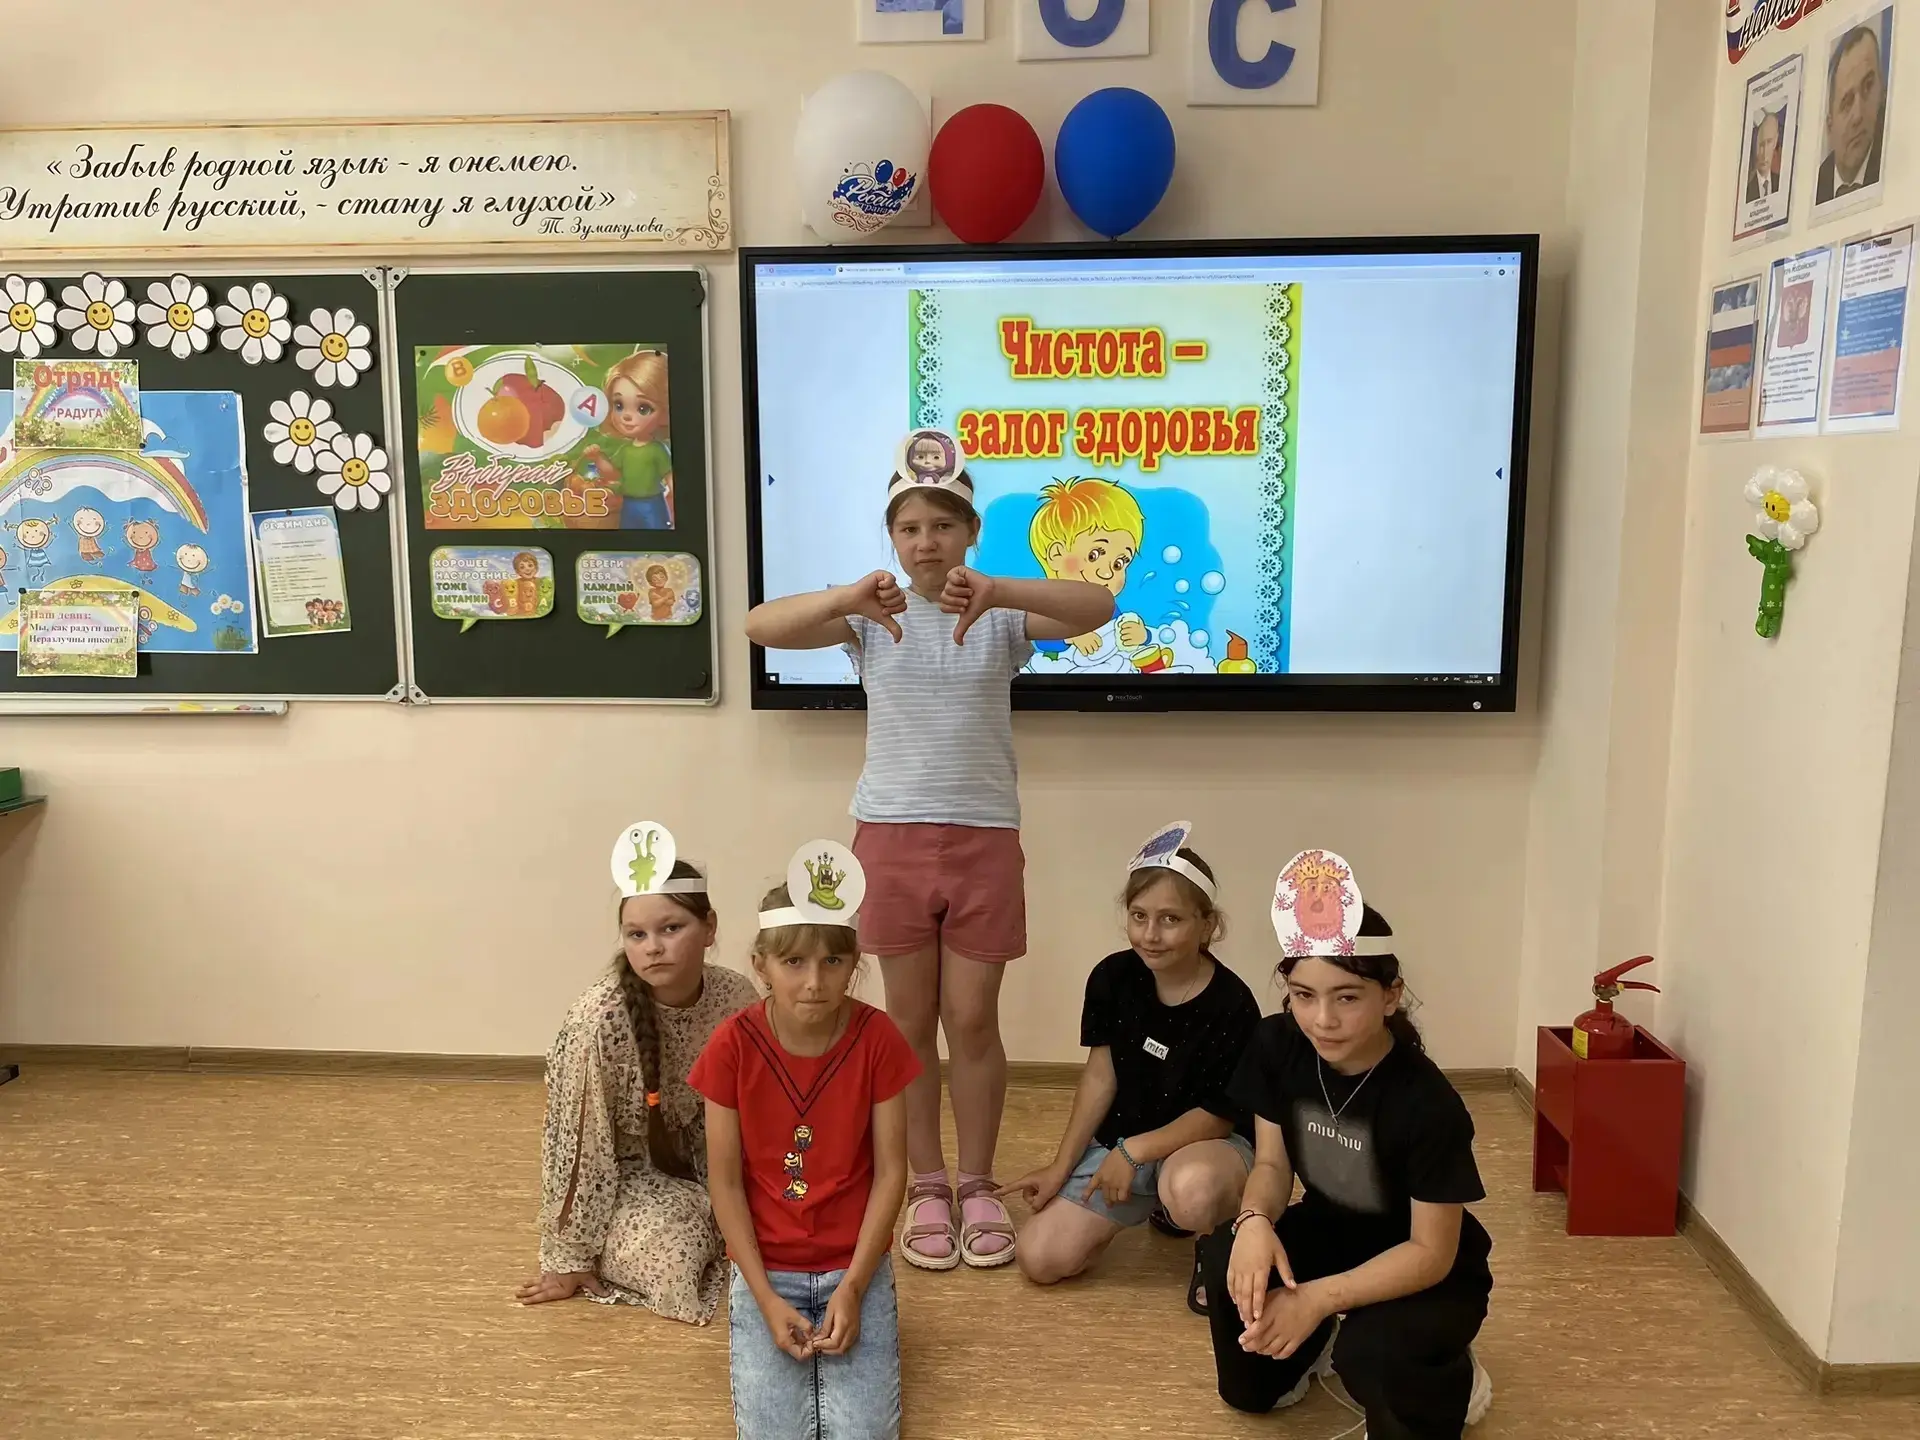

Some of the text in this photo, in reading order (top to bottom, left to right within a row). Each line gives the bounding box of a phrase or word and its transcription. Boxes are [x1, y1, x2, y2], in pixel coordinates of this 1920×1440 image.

[69, 143, 176, 179] Забыв
[178, 148, 296, 191] родной
[302, 153, 388, 190] язык
[418, 155, 441, 175] я
[448, 152, 579, 173] онемею.
[840, 173, 903, 209] Россия
[0, 186, 160, 233] Утратив
[162, 188, 308, 232] русский,
[336, 195, 444, 229] стану
[452, 195, 474, 214] я
[483, 184, 616, 228] глухой»
[537, 215, 664, 240] Т. Зумакулова
[998, 316, 1167, 378] Чистота
[33, 364, 121, 393] Отряд:
[51, 407, 110, 420] "РАДУГА"
[958, 404, 1261, 472] залог здоровья
[431, 451, 574, 499] Выбирай
[430, 488, 609, 521] ЗДОРОВЬЕ
[263, 517, 329, 531] РЕЖИМ ДНЯ
[434, 559, 489, 568] ХОРОШЕЕ
[582, 559, 624, 569] БЕРЕГИ
[582, 572, 611, 580] СЕБЯ
[436, 582, 468, 591] ТОЖЕ
[583, 580, 634, 592] КАЖДЫЙ
[437, 594, 489, 603] ВИТАМИН
[29, 610, 92, 621] Наш девиз:
[29, 623, 49, 633] Мы,
[51, 624, 68, 632] как
[69, 625, 101, 634] радуги
[29, 634, 128, 645] Неразлучны никогда!
